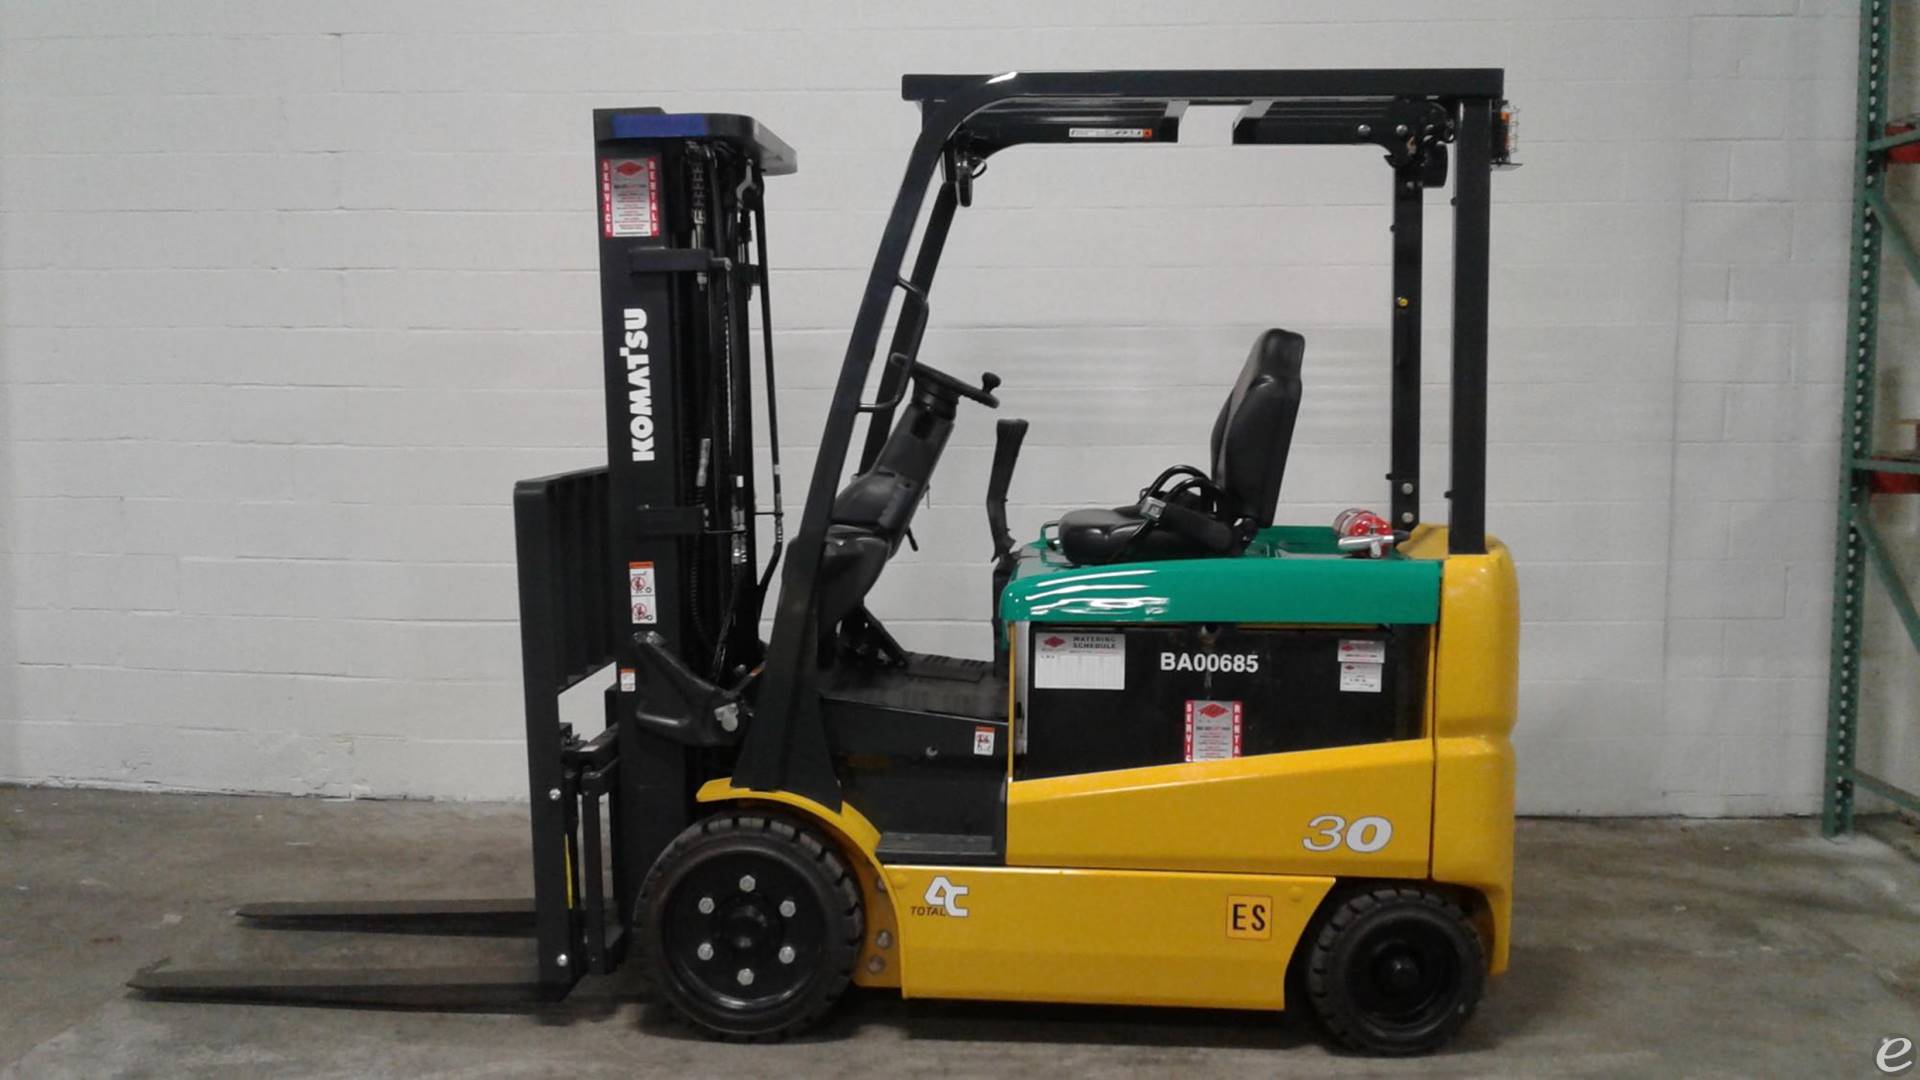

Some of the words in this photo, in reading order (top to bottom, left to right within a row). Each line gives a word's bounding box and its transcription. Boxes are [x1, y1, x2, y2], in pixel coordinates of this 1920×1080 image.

[619, 308, 655, 462] KOMATSU
[1160, 652, 1259, 673] BA00685
[1302, 815, 1393, 852] 30
[911, 906, 945, 916] TOTAL
[1232, 903, 1266, 931] ES
